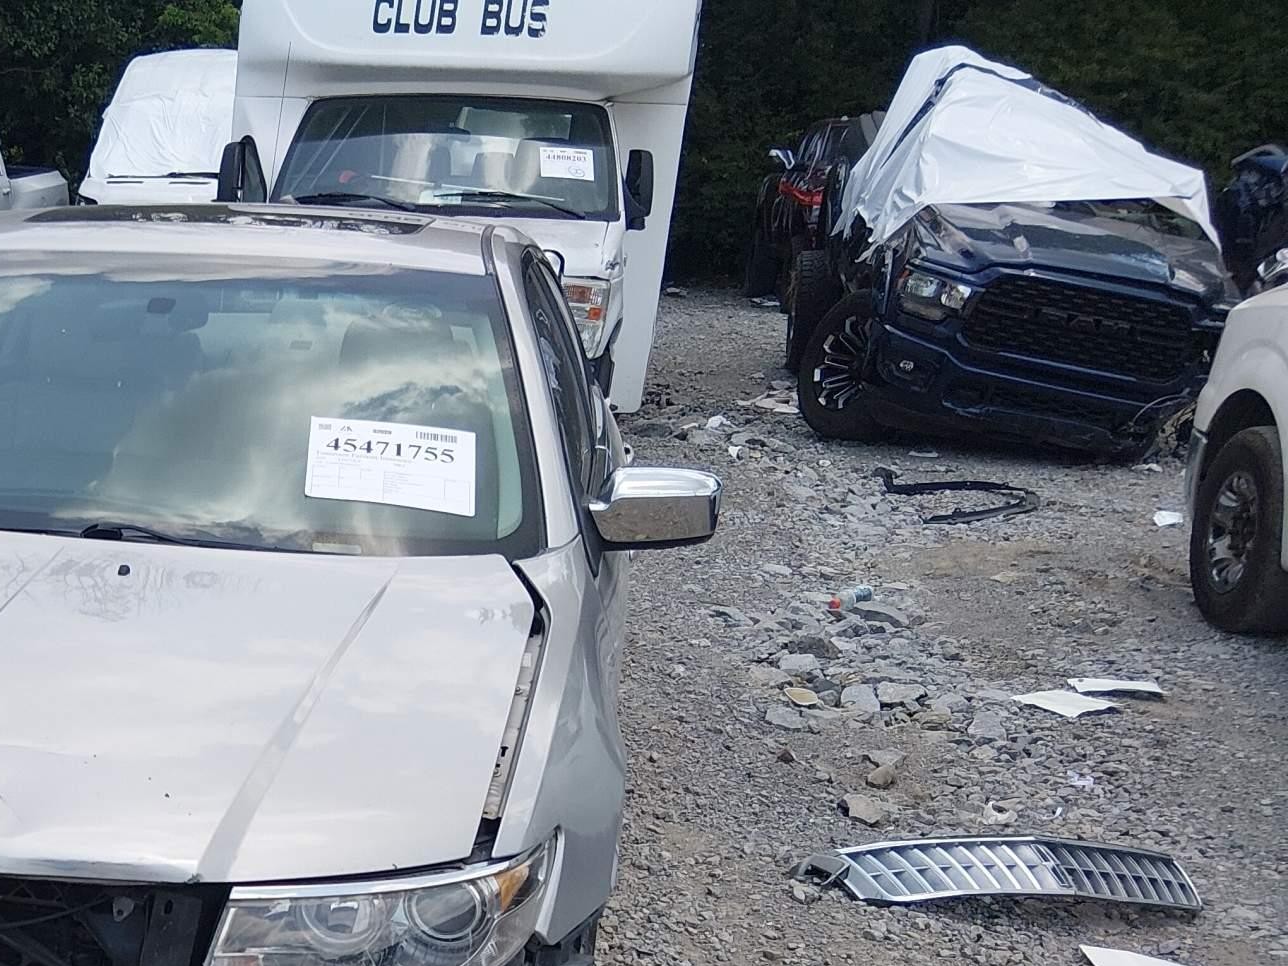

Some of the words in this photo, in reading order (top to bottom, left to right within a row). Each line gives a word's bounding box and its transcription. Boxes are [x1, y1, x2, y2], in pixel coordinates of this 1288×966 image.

[372, 0, 458, 34] CLUB
[480, 0, 550, 38] BUS
[325, 436, 456, 464] 45471755
